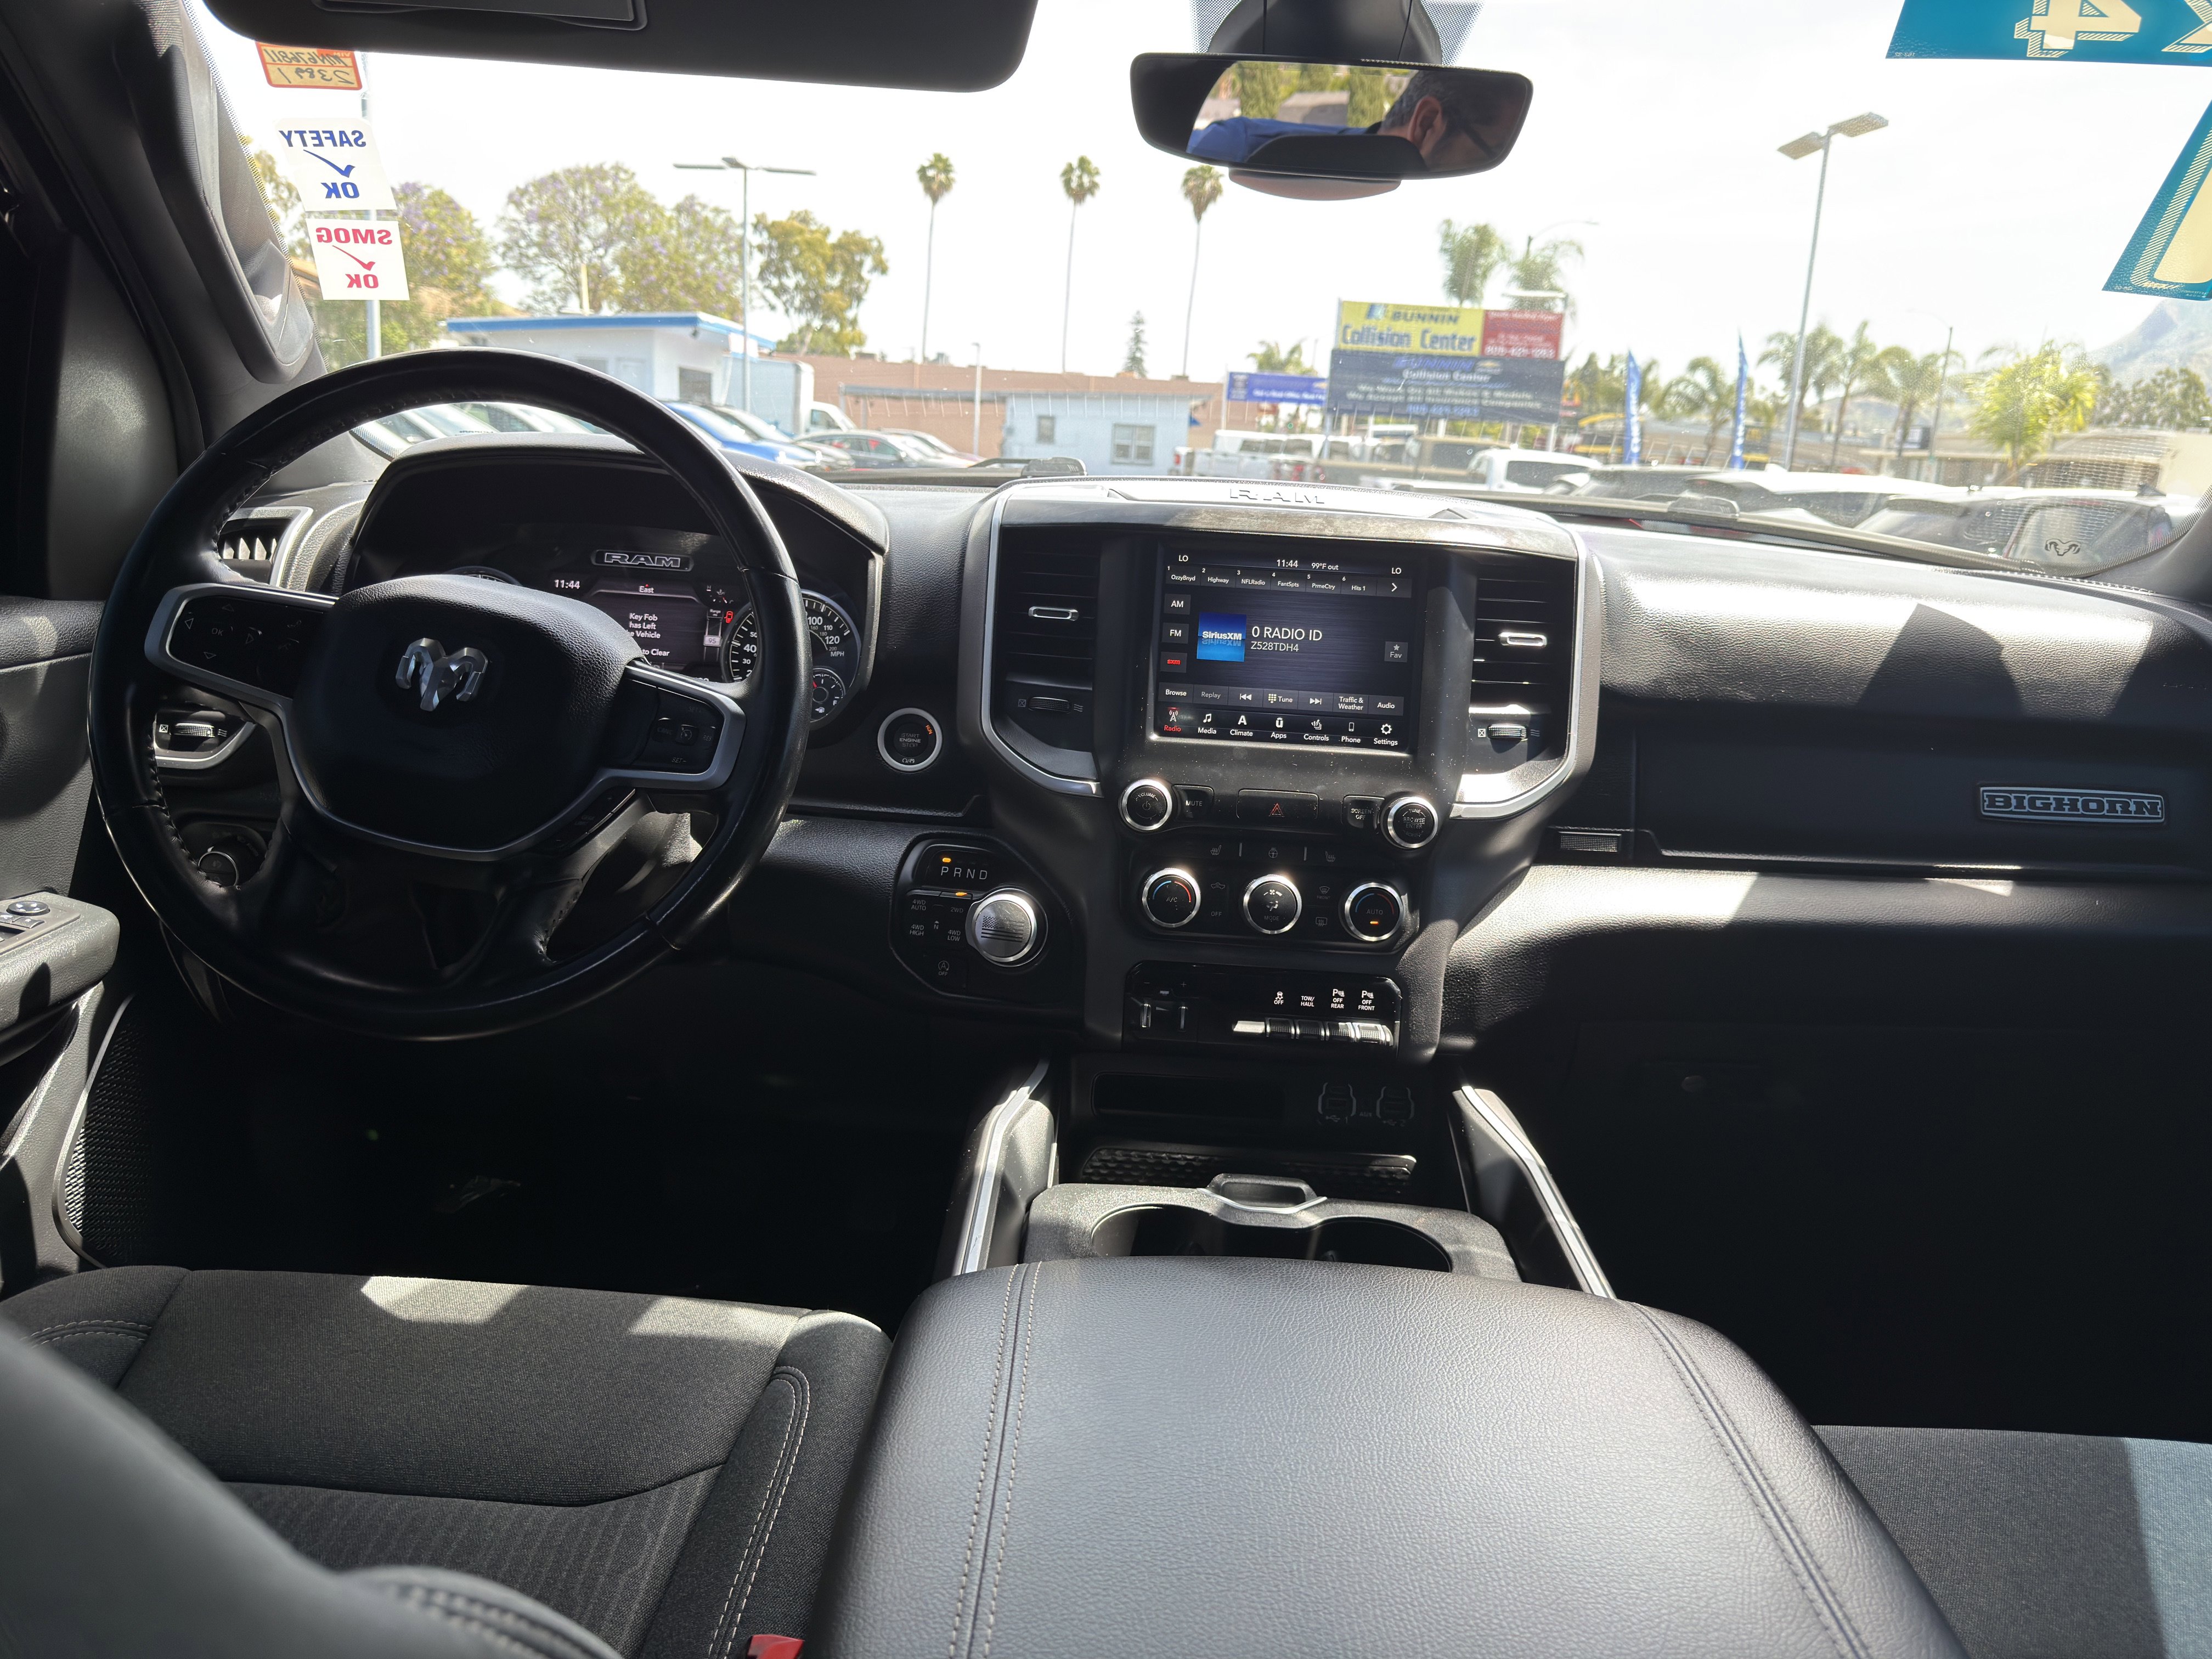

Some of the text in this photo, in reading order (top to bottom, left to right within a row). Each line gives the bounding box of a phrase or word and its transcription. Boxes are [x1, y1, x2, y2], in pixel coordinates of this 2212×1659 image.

[1392, 311, 1461, 325] BUNNIN
[1342, 324, 1412, 348] Collision
[1420, 328, 1476, 351] Center
[604, 552, 681, 568] RAM
[1277, 559, 1299, 568] 11:44
[554, 579, 580, 589] 11:44
[639, 585, 654, 594] East
[629, 613, 658, 622] Key Fob
[807, 617, 823, 625] 100
[629, 621, 656, 630] has Left
[211, 628, 224, 636] OK
[635, 631, 661, 639] Vehicle
[1202, 631, 1242, 640] SiriusXM
[1263, 627, 1305, 640] RADIO
[1309, 629, 1322, 641] ID
[825, 636, 840, 645] 120
[743, 644, 757, 653] 40
[1251, 641, 1299, 652] Z528TDH4
[651, 648, 670, 657] Clear
[1201, 691, 1221, 699] Replay
[1374, 738, 1398, 746] Settings
[1983, 792, 2161, 817] BIGHORN
[940, 866, 988, 880] P R N D
